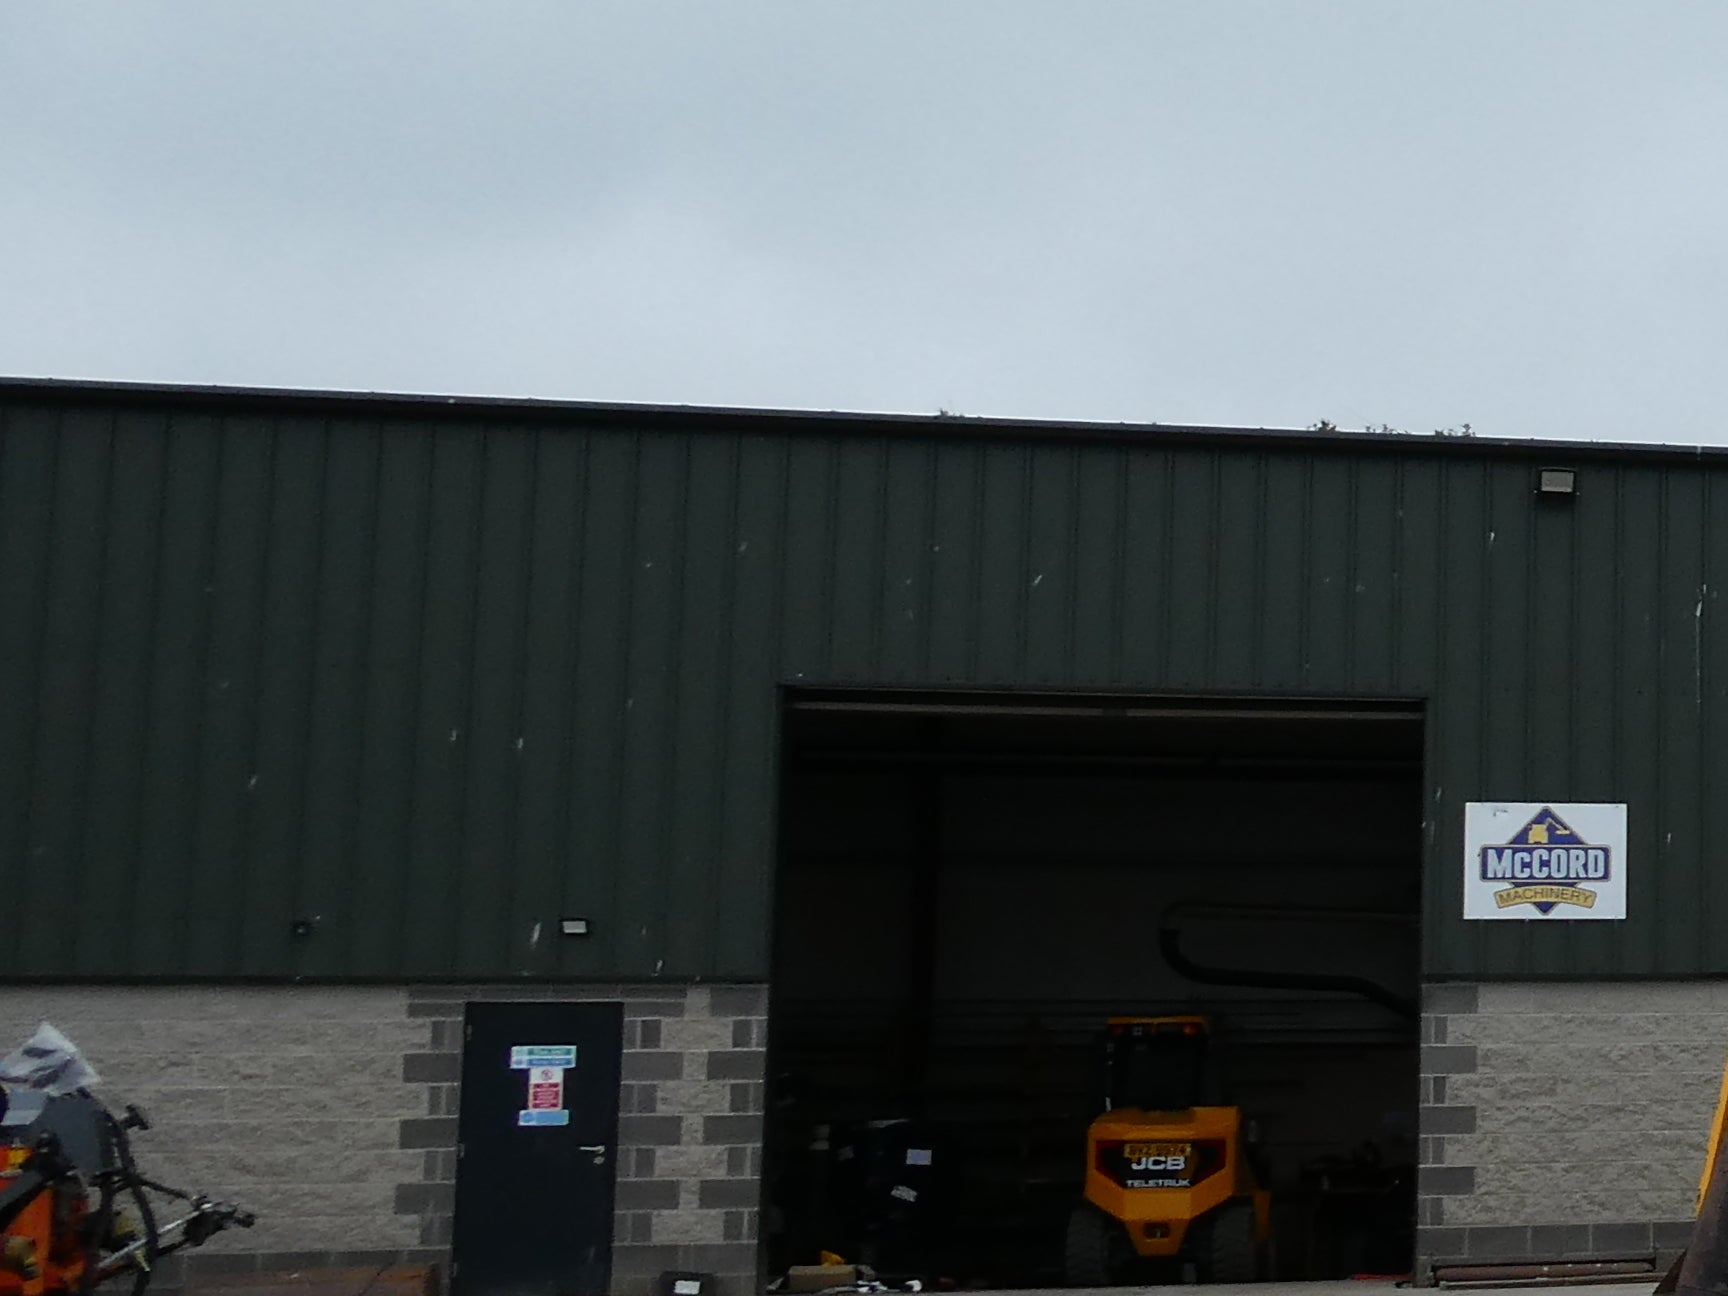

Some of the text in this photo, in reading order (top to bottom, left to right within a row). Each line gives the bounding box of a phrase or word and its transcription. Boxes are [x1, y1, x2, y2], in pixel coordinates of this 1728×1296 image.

[1486, 849, 1605, 879] McCORD
[1498, 887, 1593, 904] MACHINERY
[1131, 1157, 1185, 1170] JCB
[1126, 1179, 1190, 1188] TELETRUK
